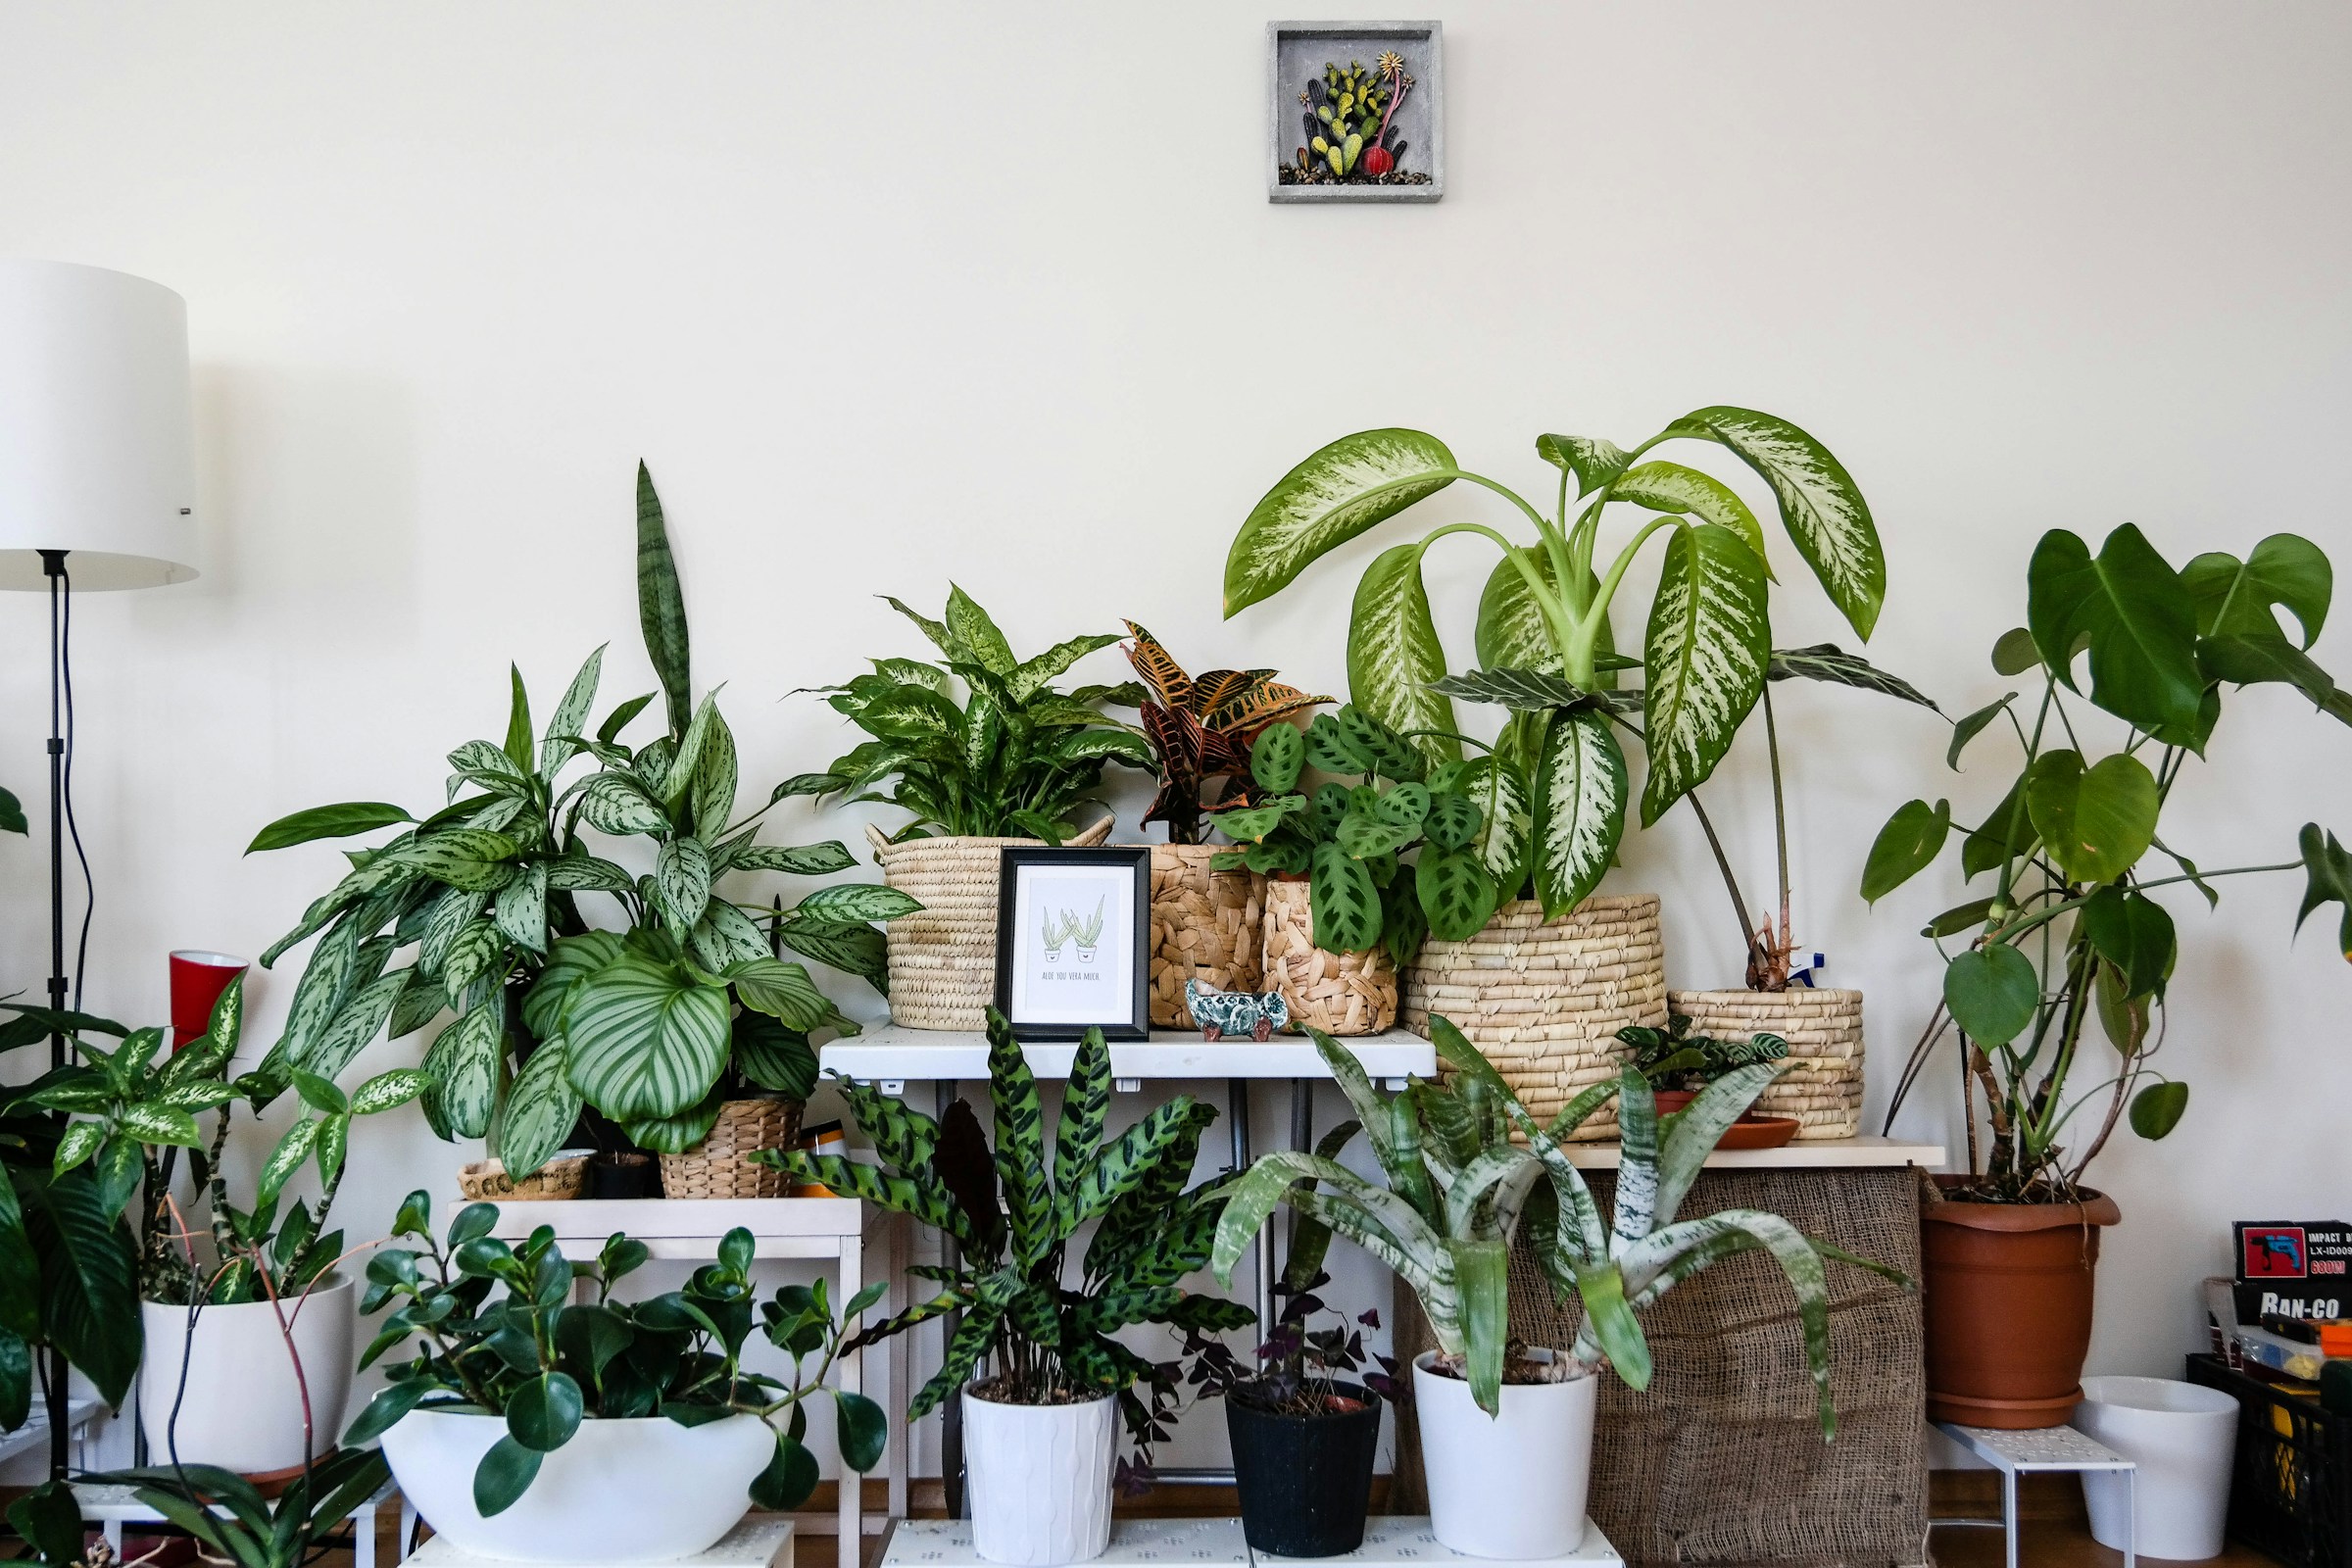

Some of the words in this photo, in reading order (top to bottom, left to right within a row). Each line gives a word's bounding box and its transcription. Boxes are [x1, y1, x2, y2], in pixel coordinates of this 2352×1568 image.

[1042, 971, 1054, 980] ALOE
[1056, 971, 1066, 980] YOU
[1068, 971, 1081, 980] VERA
[2308, 1232, 2340, 1243] IMPACT
[2311, 1260, 2345, 1274] 680W
